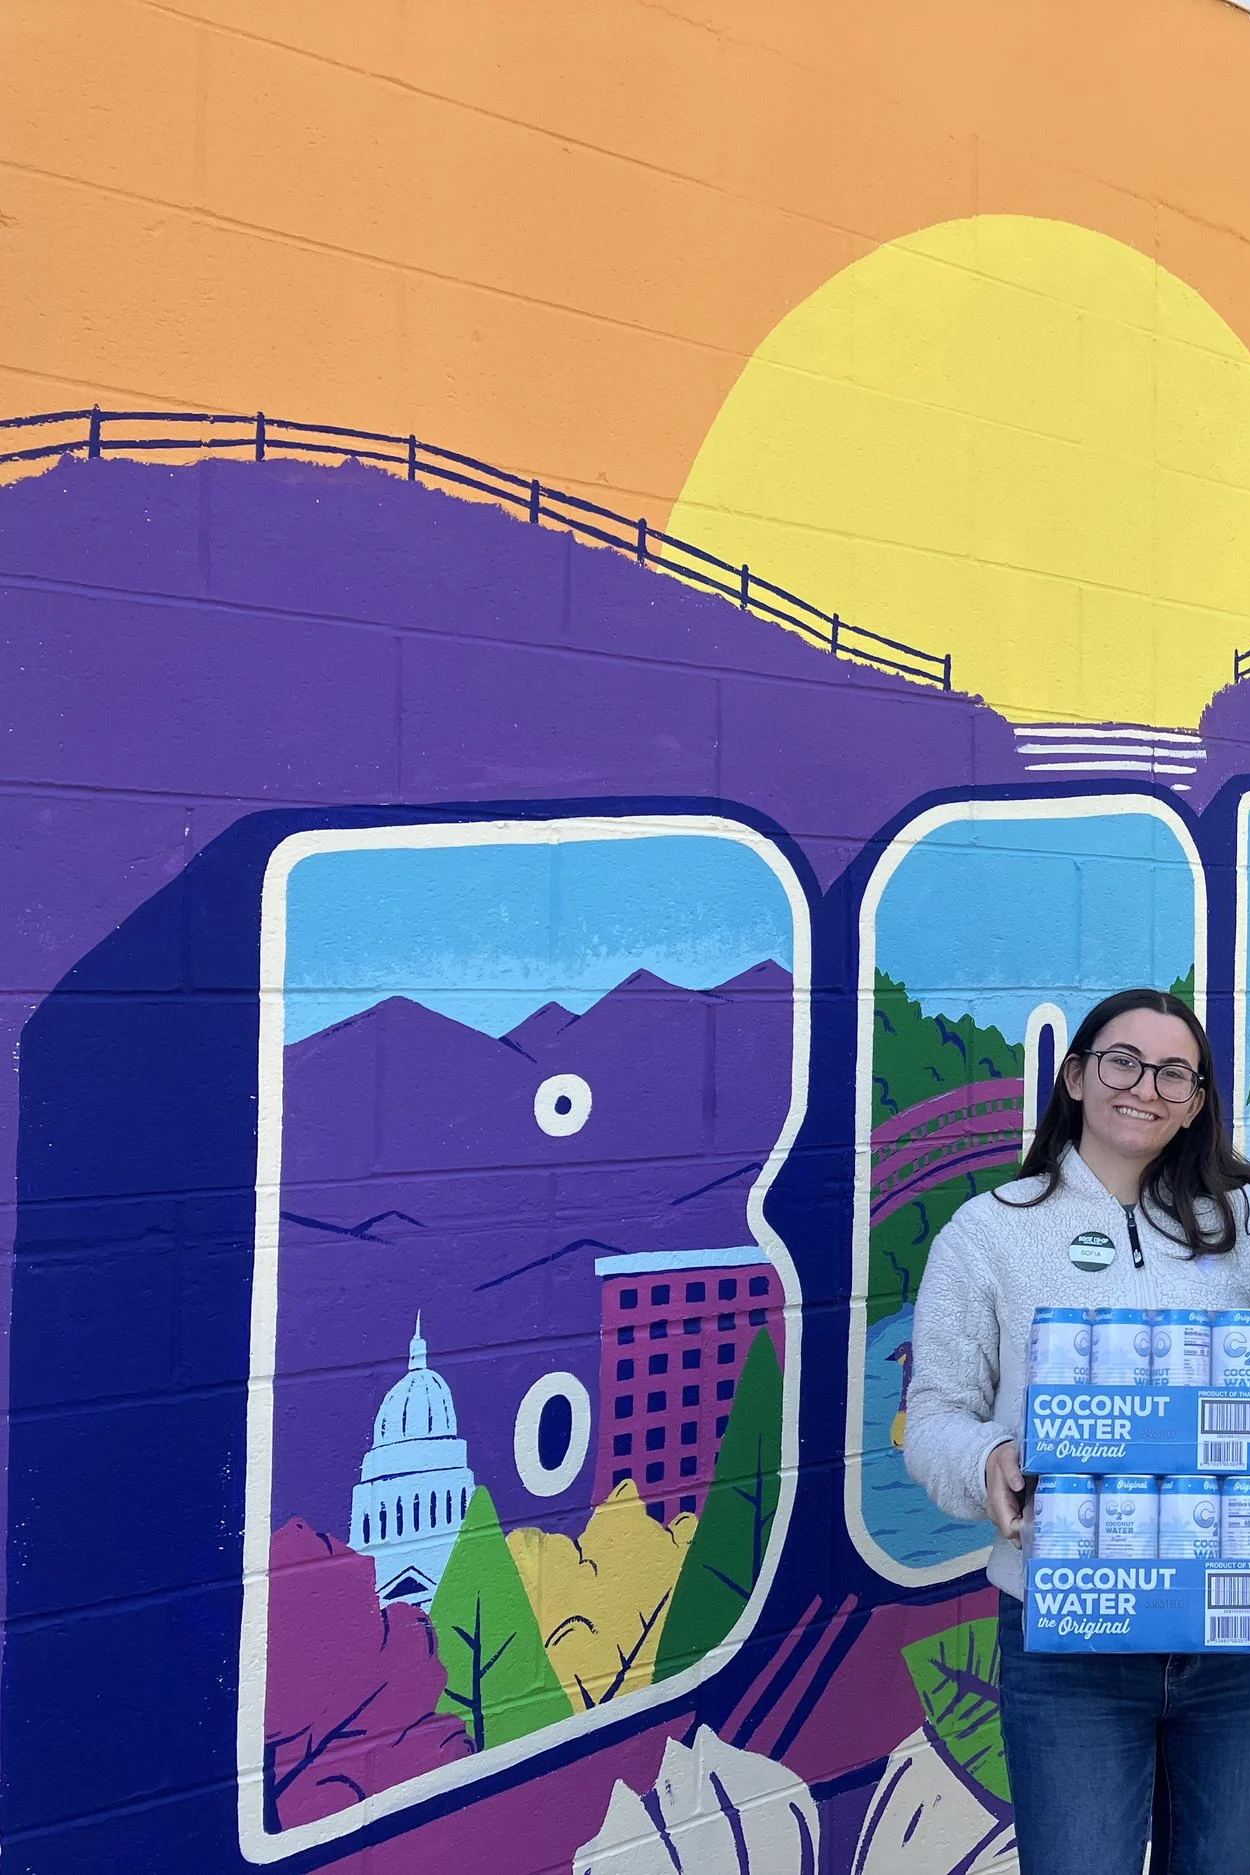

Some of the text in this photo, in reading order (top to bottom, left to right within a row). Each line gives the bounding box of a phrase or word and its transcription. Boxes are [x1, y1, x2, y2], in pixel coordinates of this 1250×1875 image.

[1033, 1394, 1170, 1417] COCONUT
[1033, 1418, 1132, 1440] WATER
[1036, 1440, 1126, 1463] the Original
[1117, 1480, 1147, 1491] Original
[1034, 1567, 1176, 1590] COCONUT
[1034, 1593, 1136, 1615] WATER
[1038, 1616, 1131, 1640] the Original
